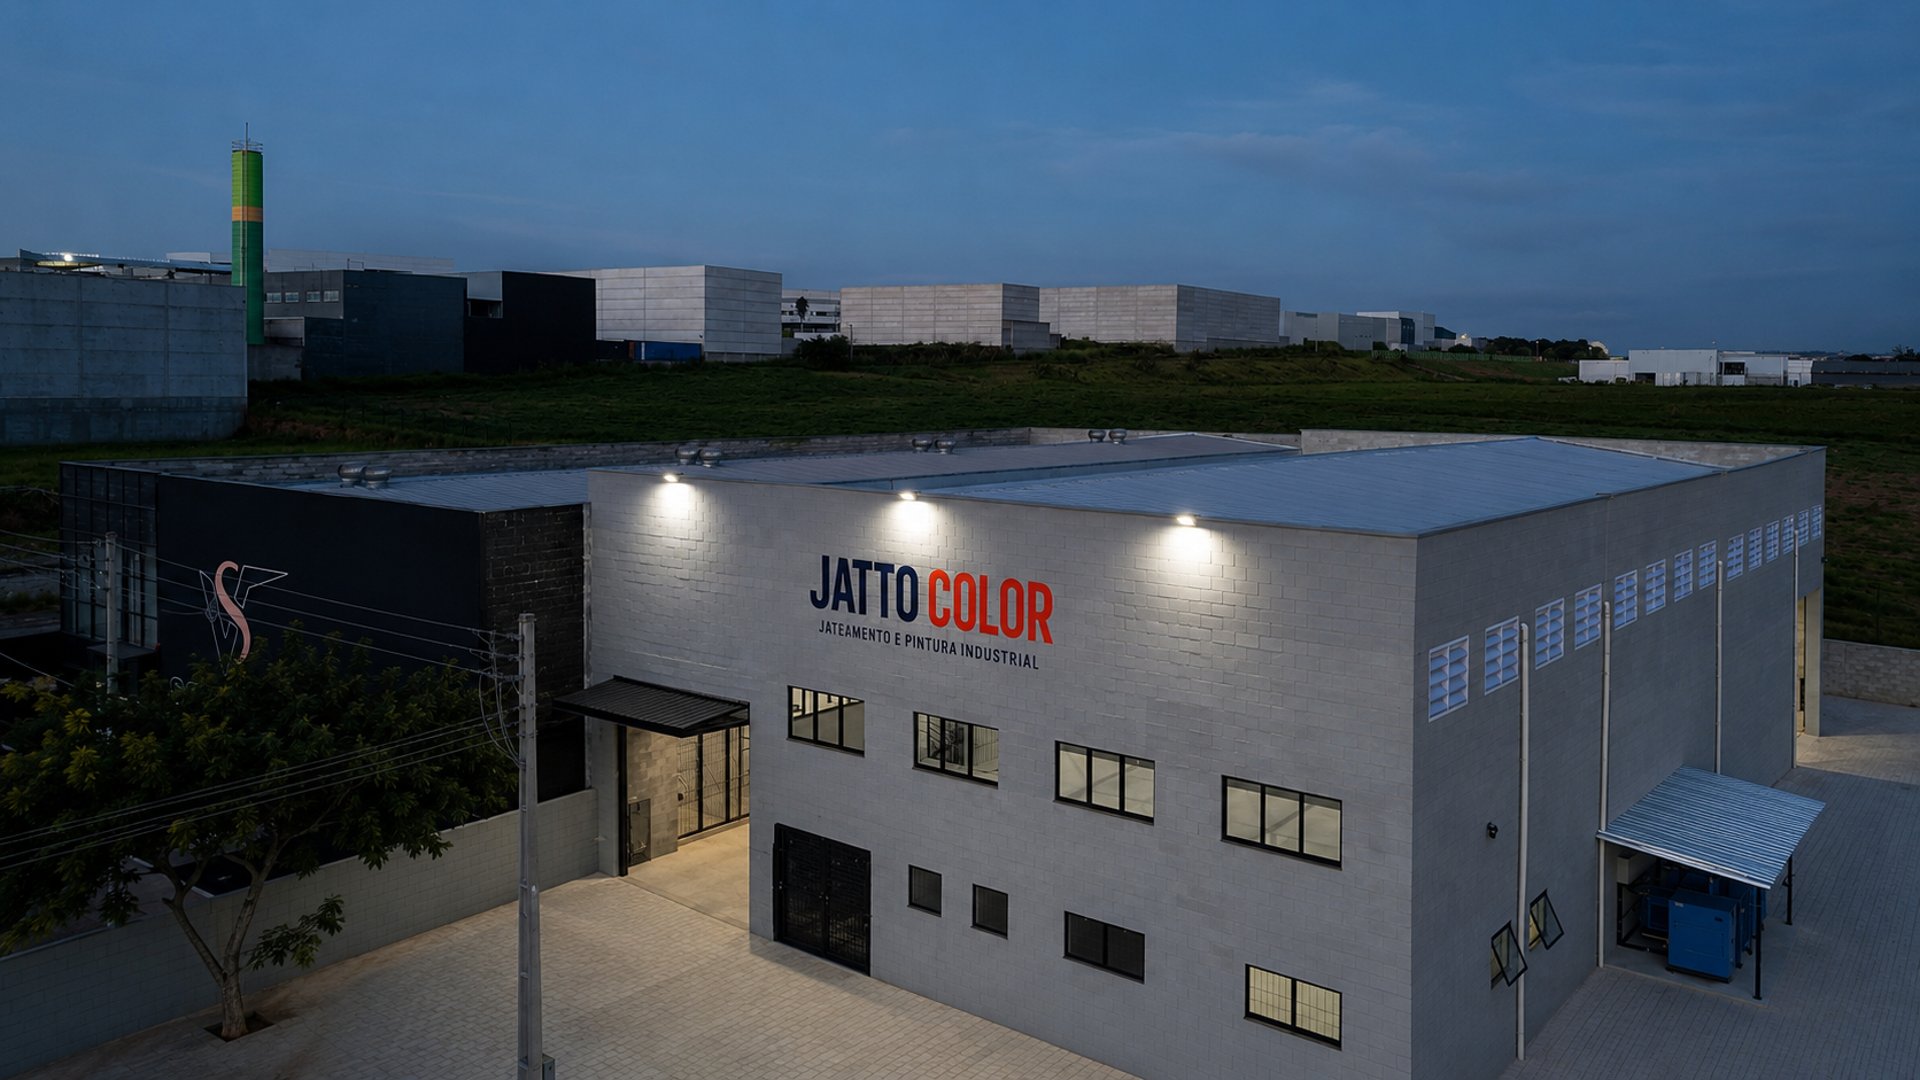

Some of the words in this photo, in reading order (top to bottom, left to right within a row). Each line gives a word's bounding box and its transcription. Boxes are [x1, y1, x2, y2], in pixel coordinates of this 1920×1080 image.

[810, 555, 918, 622] JATTO
[928, 569, 1053, 644] COLOR
[819, 620, 891, 644] JATEAMENTO
[894, 632, 901, 646] E
[905, 634, 957, 656] PINTURA
[961, 643, 1039, 670] INDUSTRIAL
